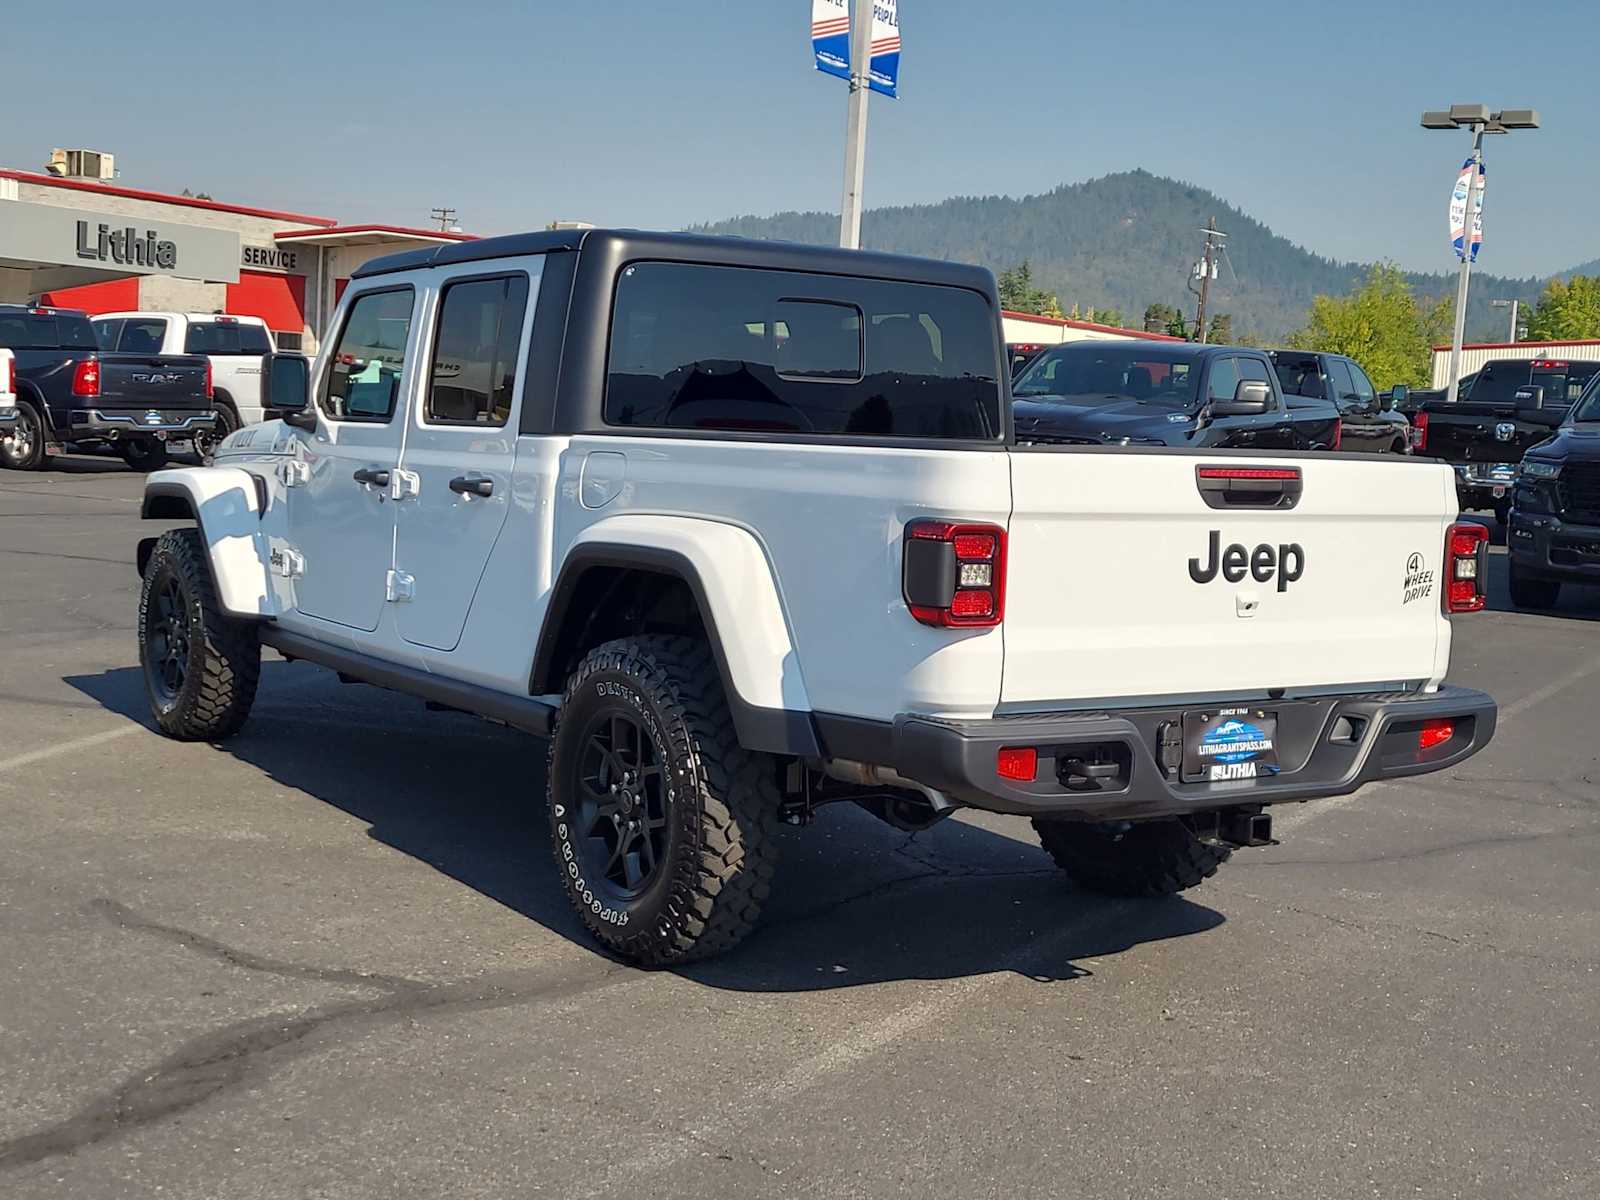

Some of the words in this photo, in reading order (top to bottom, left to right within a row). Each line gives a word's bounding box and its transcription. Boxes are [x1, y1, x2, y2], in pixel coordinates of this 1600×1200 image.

[76, 220, 177, 269] Lithia
[244, 247, 297, 268] SERVICE
[1188, 529, 1305, 593] Jeep
[1403, 570, 1434, 590] WHEEL
[1403, 585, 1432, 606] DRIVE
